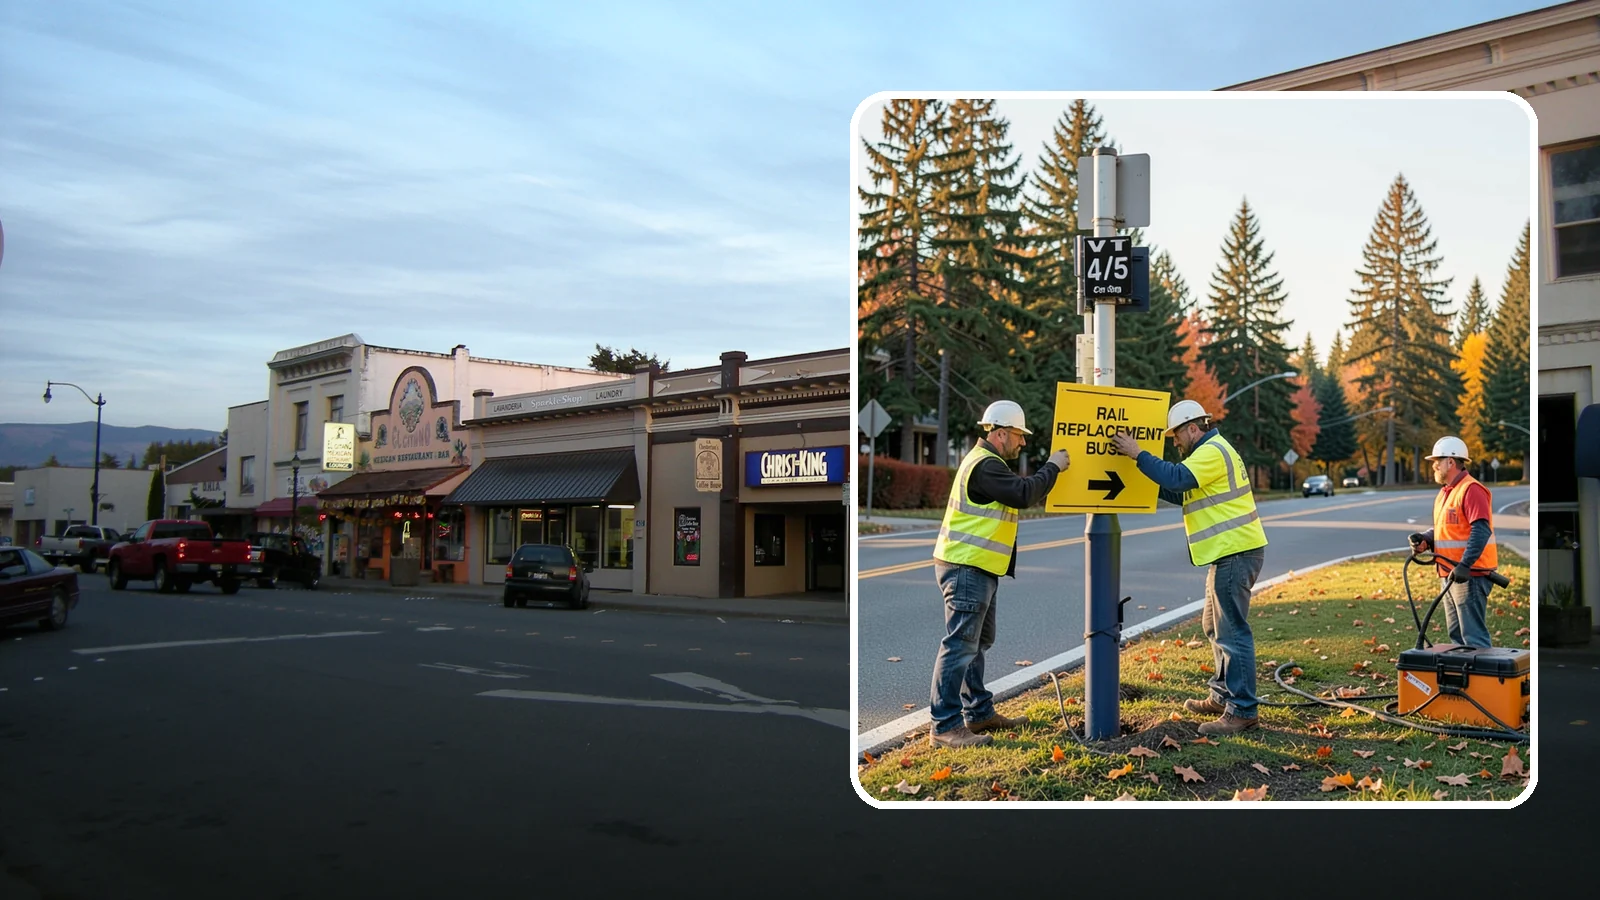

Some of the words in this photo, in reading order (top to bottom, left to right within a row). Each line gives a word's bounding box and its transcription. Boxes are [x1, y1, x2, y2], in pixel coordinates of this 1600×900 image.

[1087, 256, 1128, 281] 4/5
[493, 402, 523, 413] LAVANDERIA
[562, 394, 582, 405] Shop
[595, 389, 624, 400] LAUNDRY
[1096, 406, 1129, 421] RAIL
[1056, 422, 1164, 441] REPLACEMENT
[373, 455, 396, 464] MEXICAN
[397, 451, 433, 462] RESTAURANT
[437, 450, 450, 459] BAR
[761, 452, 797, 478] CHRIST
[799, 450, 827, 476] KING
